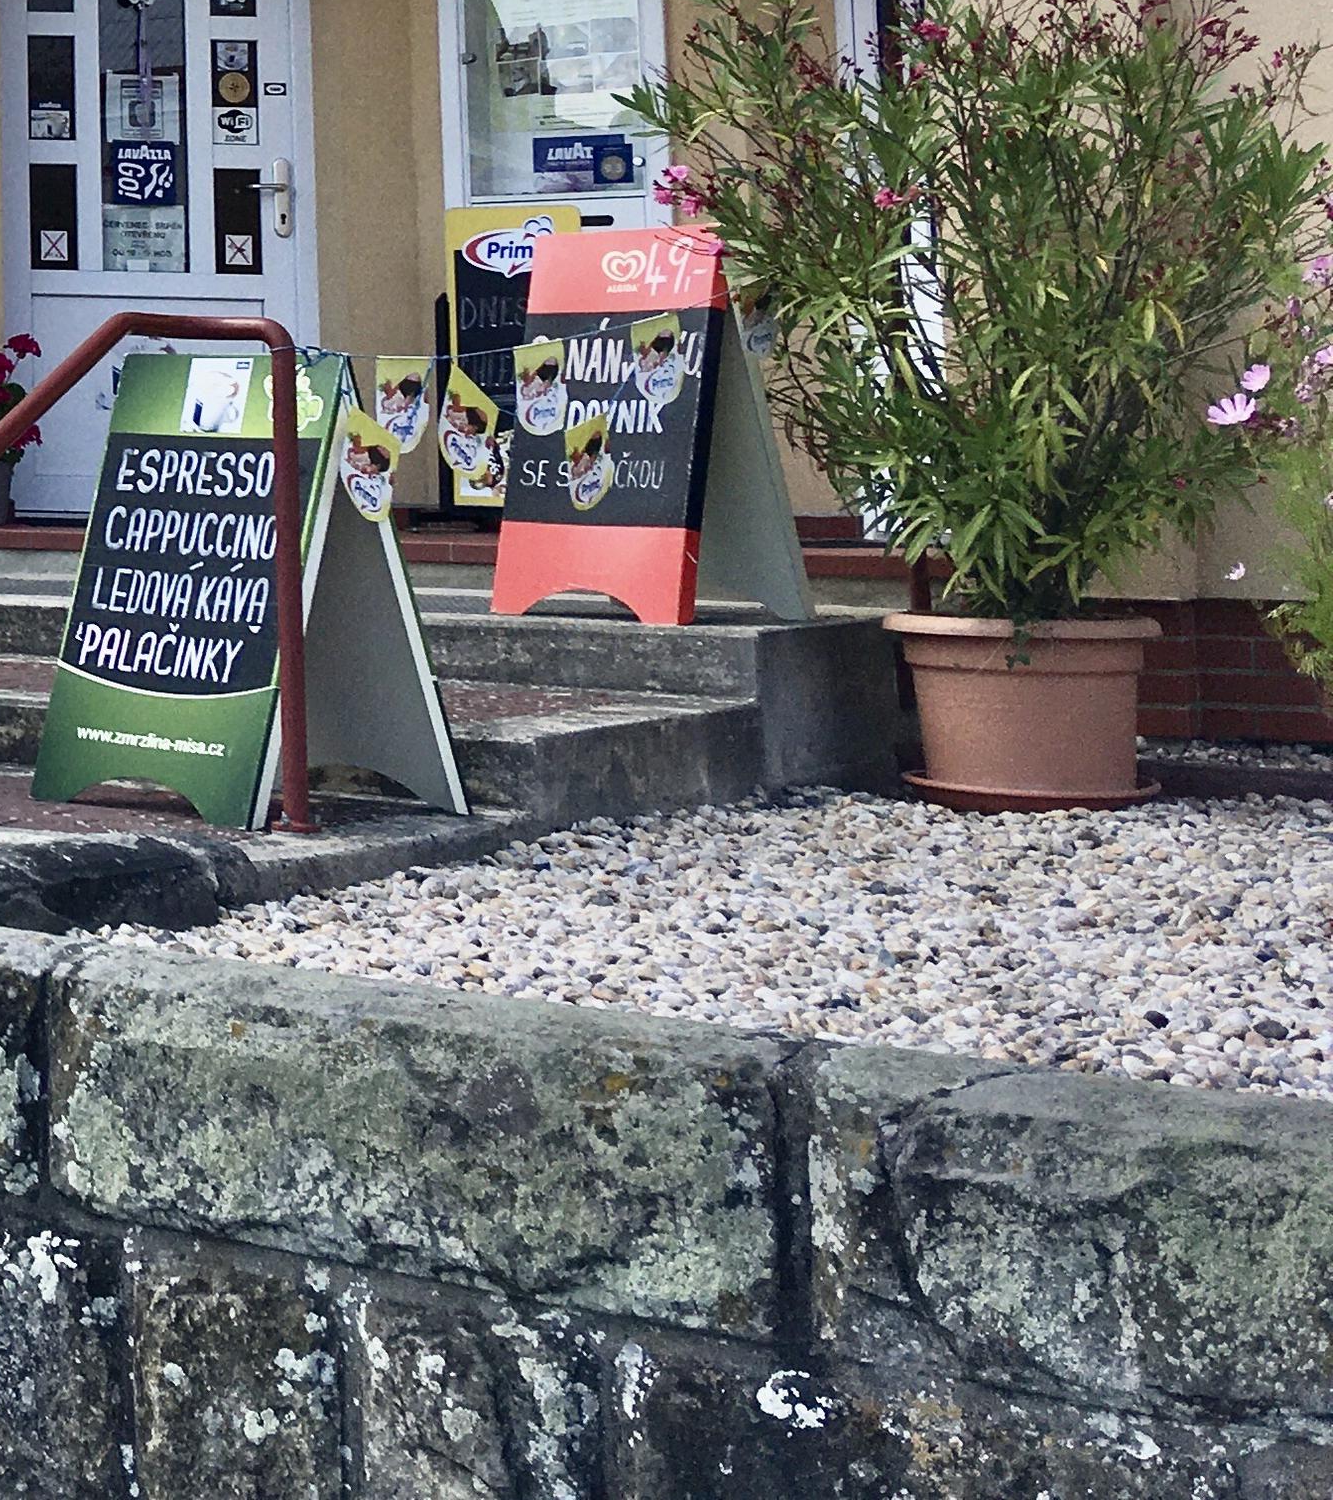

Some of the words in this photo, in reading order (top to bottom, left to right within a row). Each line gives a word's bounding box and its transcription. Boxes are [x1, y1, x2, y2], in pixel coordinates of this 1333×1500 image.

[117, 145, 172, 160] LAVAZZA
[546, 142, 594, 161] LAVAZ
[118, 162, 145, 199] GO!
[486, 241, 533, 261] Prim
[606, 283, 638, 294] ALGIDA
[116, 448, 275, 499] ESPRESSO
[520, 459, 550, 488] SE
[105, 505, 277, 560] CAPPUCCINO
[92, 561, 204, 620] LEDOVÁ
[194, 562, 269, 625] KÁVA
[77, 622, 244, 685] PALAČINKY
